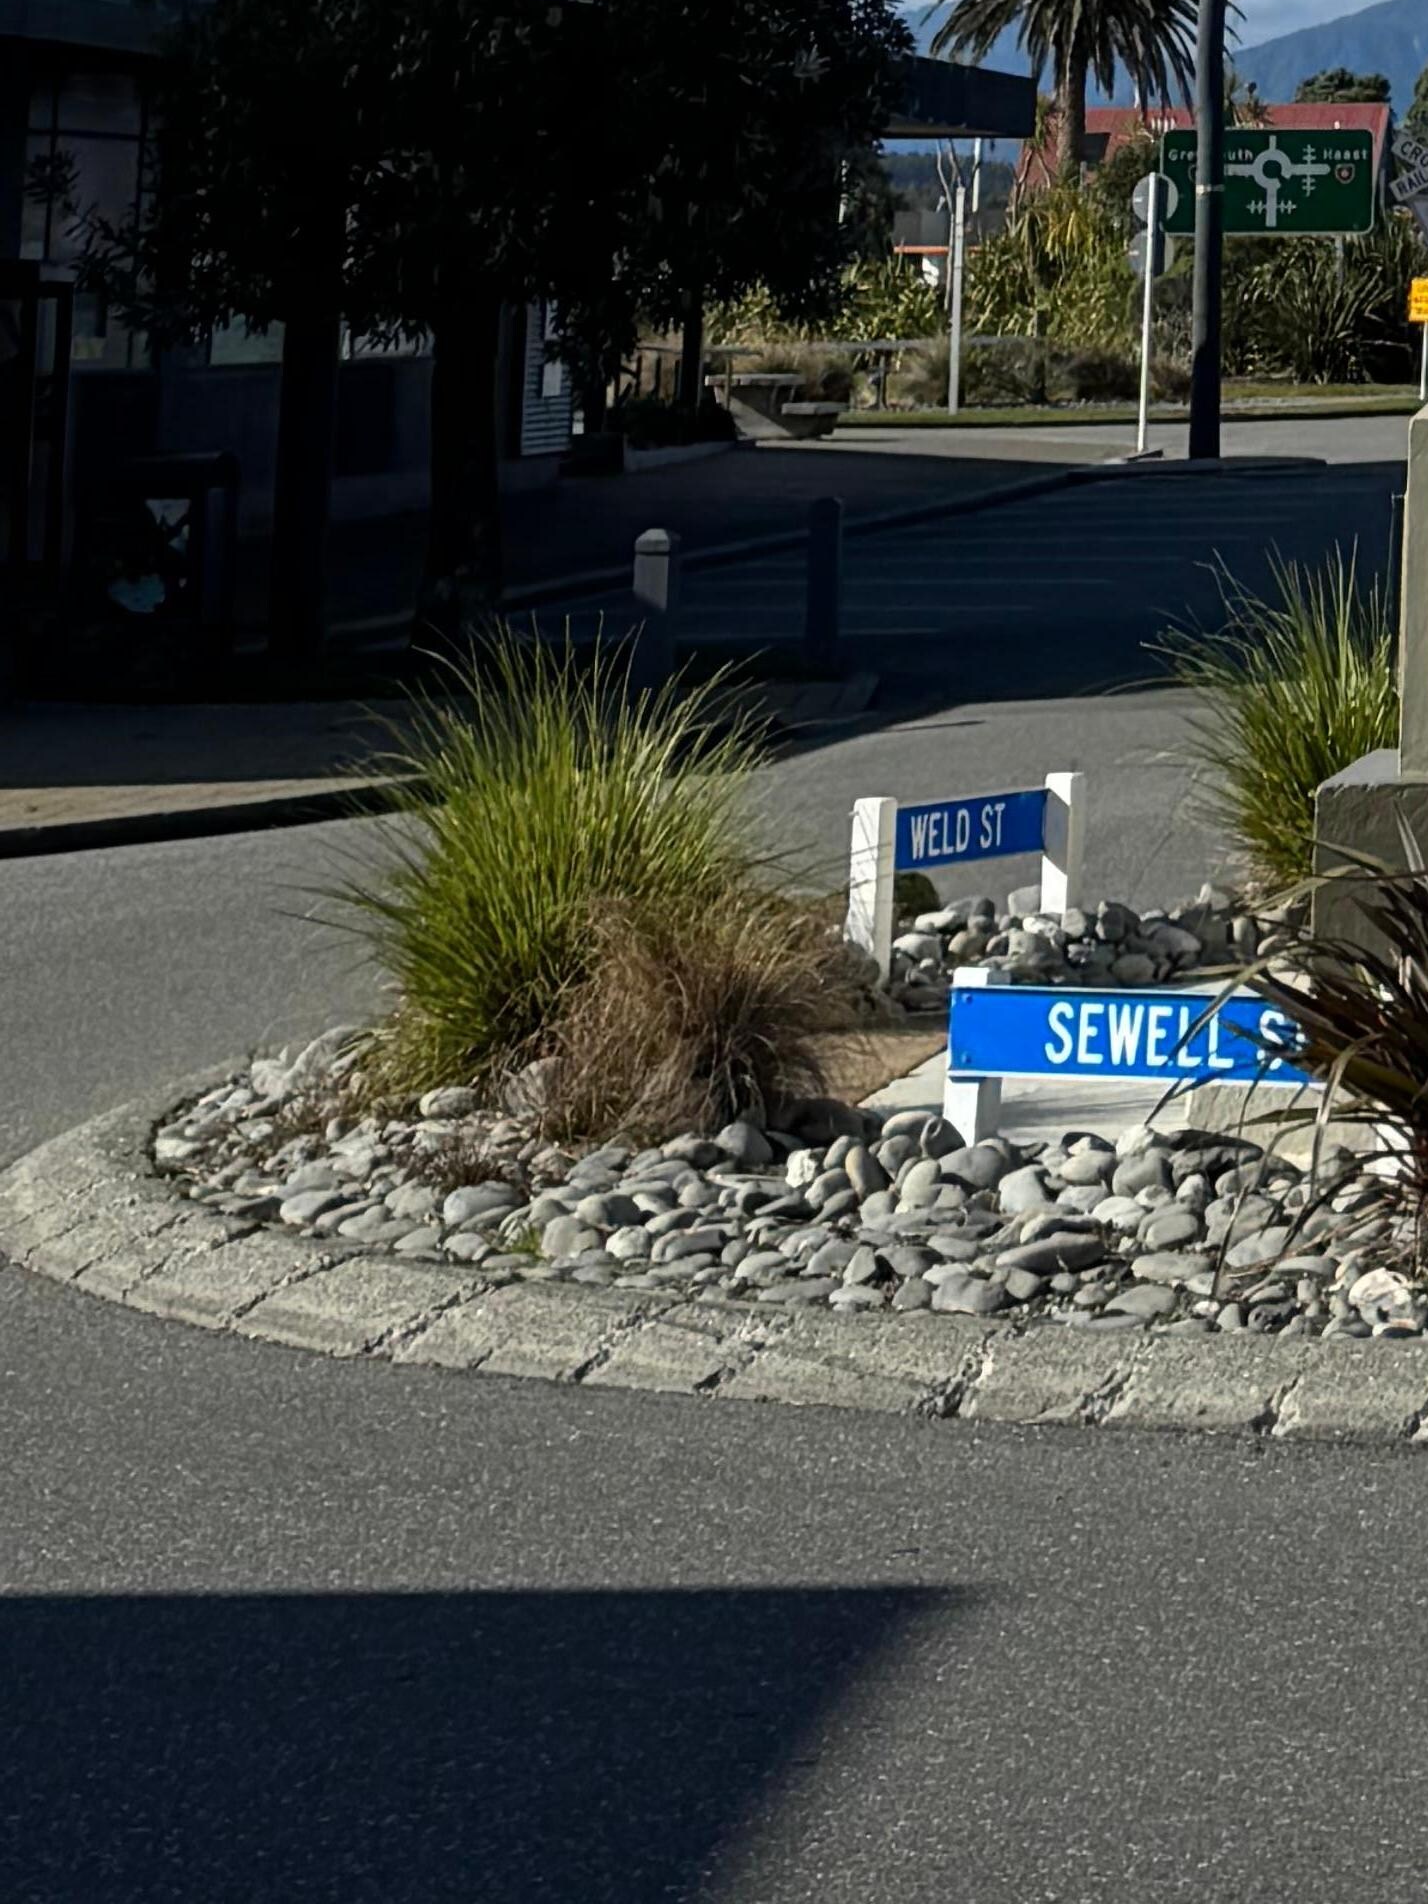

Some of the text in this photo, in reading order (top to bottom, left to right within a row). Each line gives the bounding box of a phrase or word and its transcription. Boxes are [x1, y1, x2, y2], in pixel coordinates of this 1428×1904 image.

[1168, 147, 1254, 162] Greuth
[1322, 148, 1369, 160] Haast
[910, 802, 1007, 860] WELD ST
[1044, 1000, 1235, 1070] SEWELL
